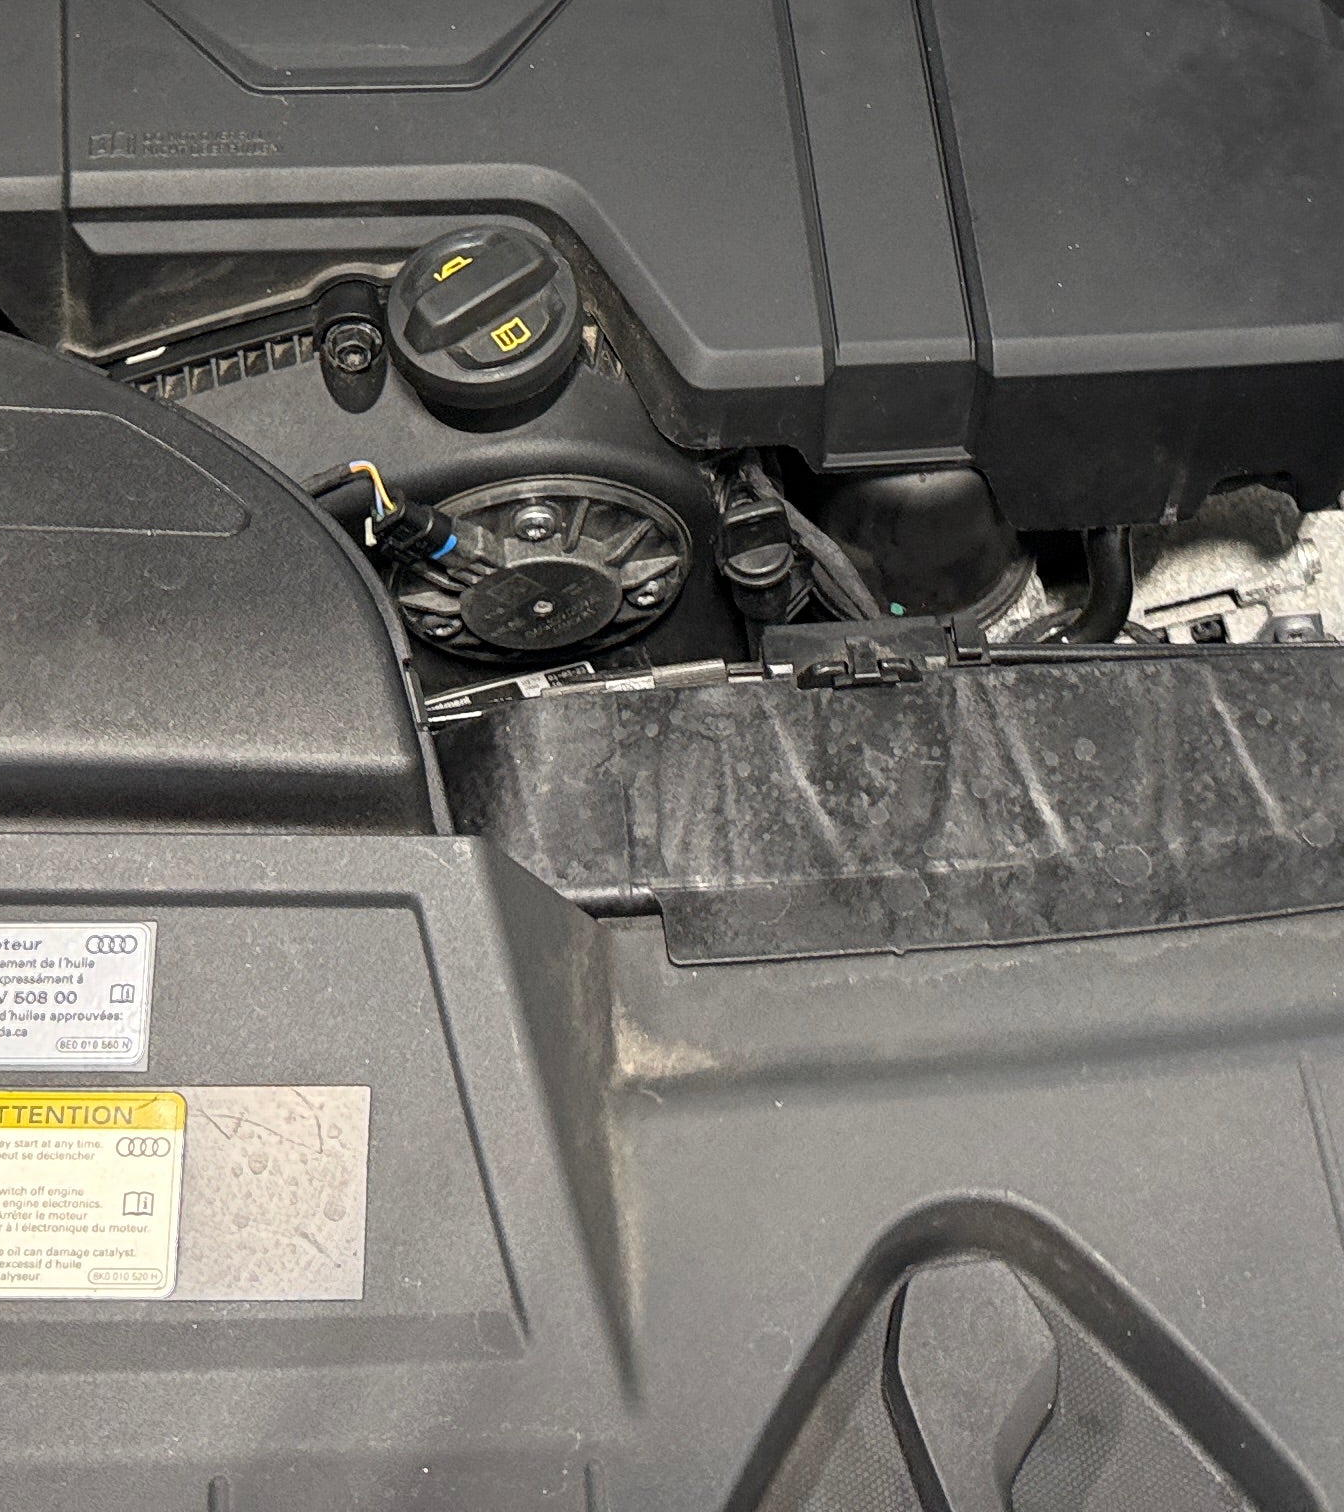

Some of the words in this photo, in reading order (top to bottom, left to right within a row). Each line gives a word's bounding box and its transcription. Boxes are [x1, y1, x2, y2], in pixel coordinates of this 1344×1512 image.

[39, 957, 55, 970] de
[13, 990, 49, 1005] 508
[53, 990, 78, 1005] 00
[49, 1010, 124, 1024] approuvées:
[14, 1139, 39, 1149] start
[41, 1139, 52, 1149] at
[53, 1140, 73, 1151] any
[76, 1139, 104, 1149] time.
[21, 1152, 34, 1161] se
[30, 1186, 45, 1197] off
[47, 1187, 85, 1199] engine
[2, 1199, 40, 1211] engine
[42, 1198, 104, 1209] electronics.
[35, 1210, 46, 1220] le
[47, 1211, 88, 1221] moteur
[91, 1223, 106, 1233] du
[7, 1246, 21, 1257] oil
[23, 1248, 43, 1257] can
[45, 1247, 90, 1259] damage
[92, 1247, 136, 1259] catalyst.
[112, 1272, 130, 1281] 010
[131, 1272, 149, 1281] 520
